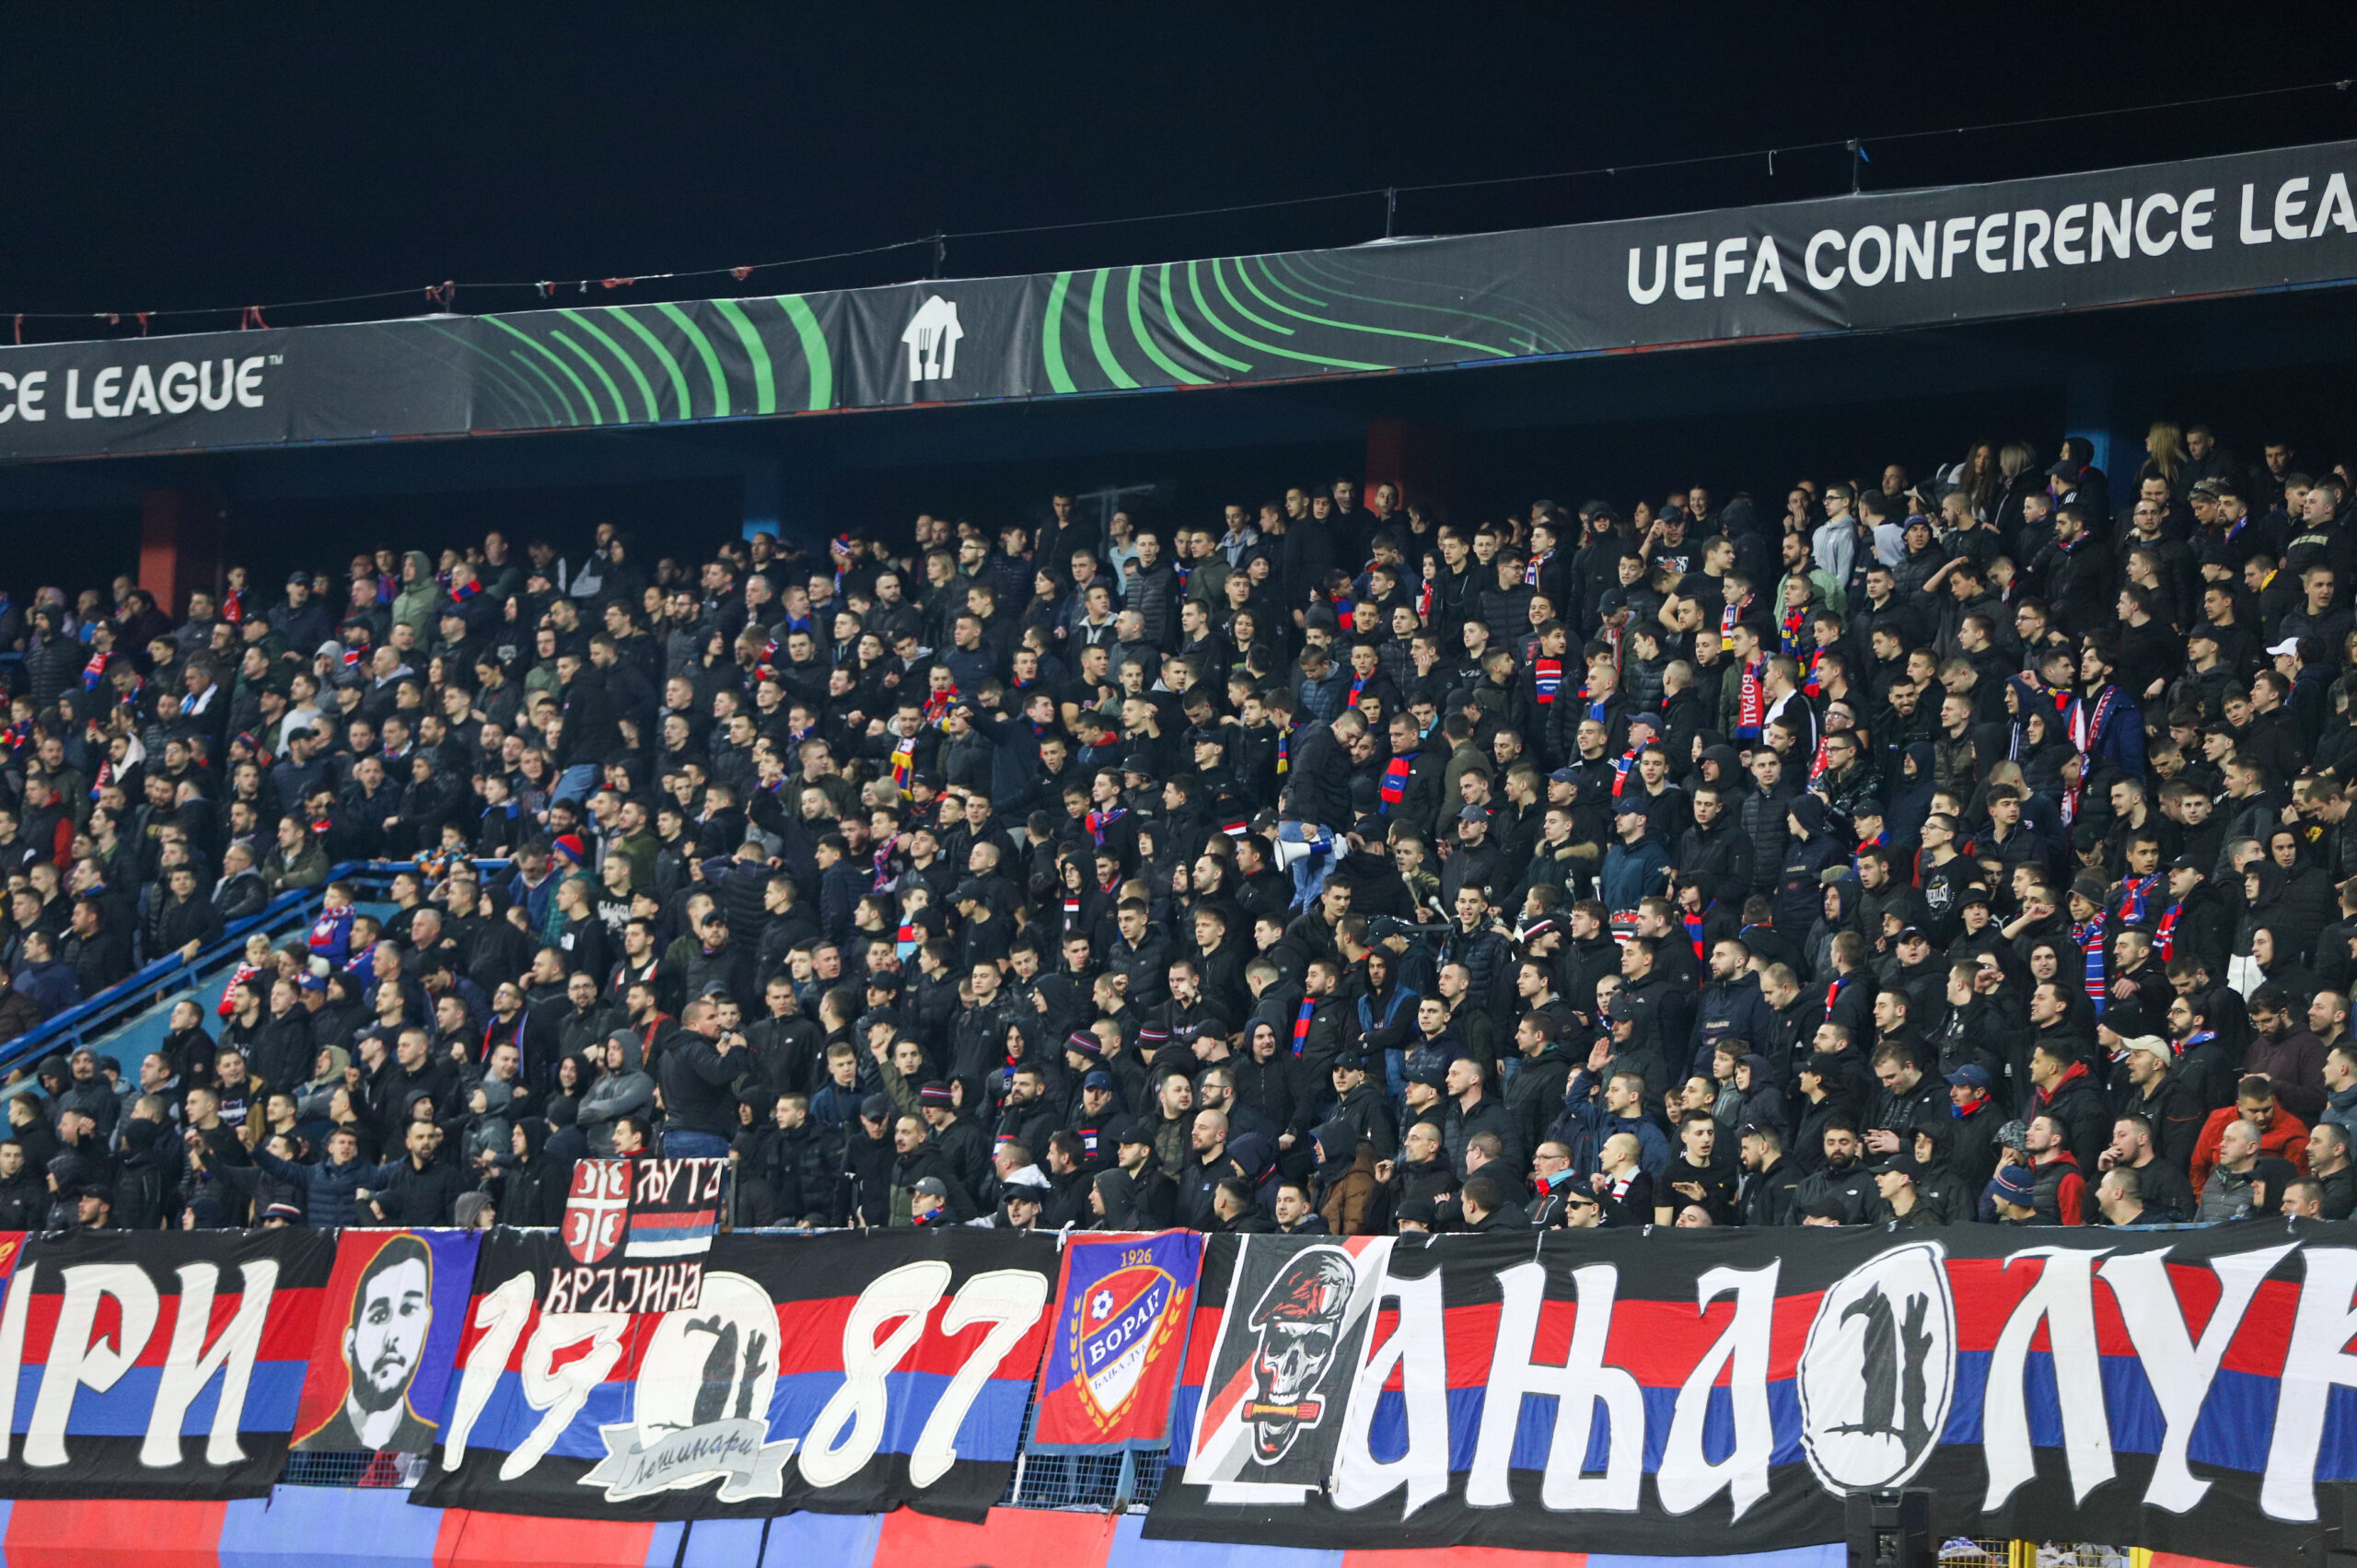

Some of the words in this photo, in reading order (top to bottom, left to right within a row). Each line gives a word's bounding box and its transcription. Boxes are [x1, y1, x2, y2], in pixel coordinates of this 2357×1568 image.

[1628, 235, 1788, 305] UEFA
[1805, 188, 2216, 291] CONFERENCE
[2240, 172, 2357, 245] LEA
[1741, 673, 1758, 726] БОРАЦ
[1120, 1249, 1153, 1268] 1926
[541, 1261, 703, 1314] КРАЈИНА
[1206, 1256, 1782, 1526] АЊА
